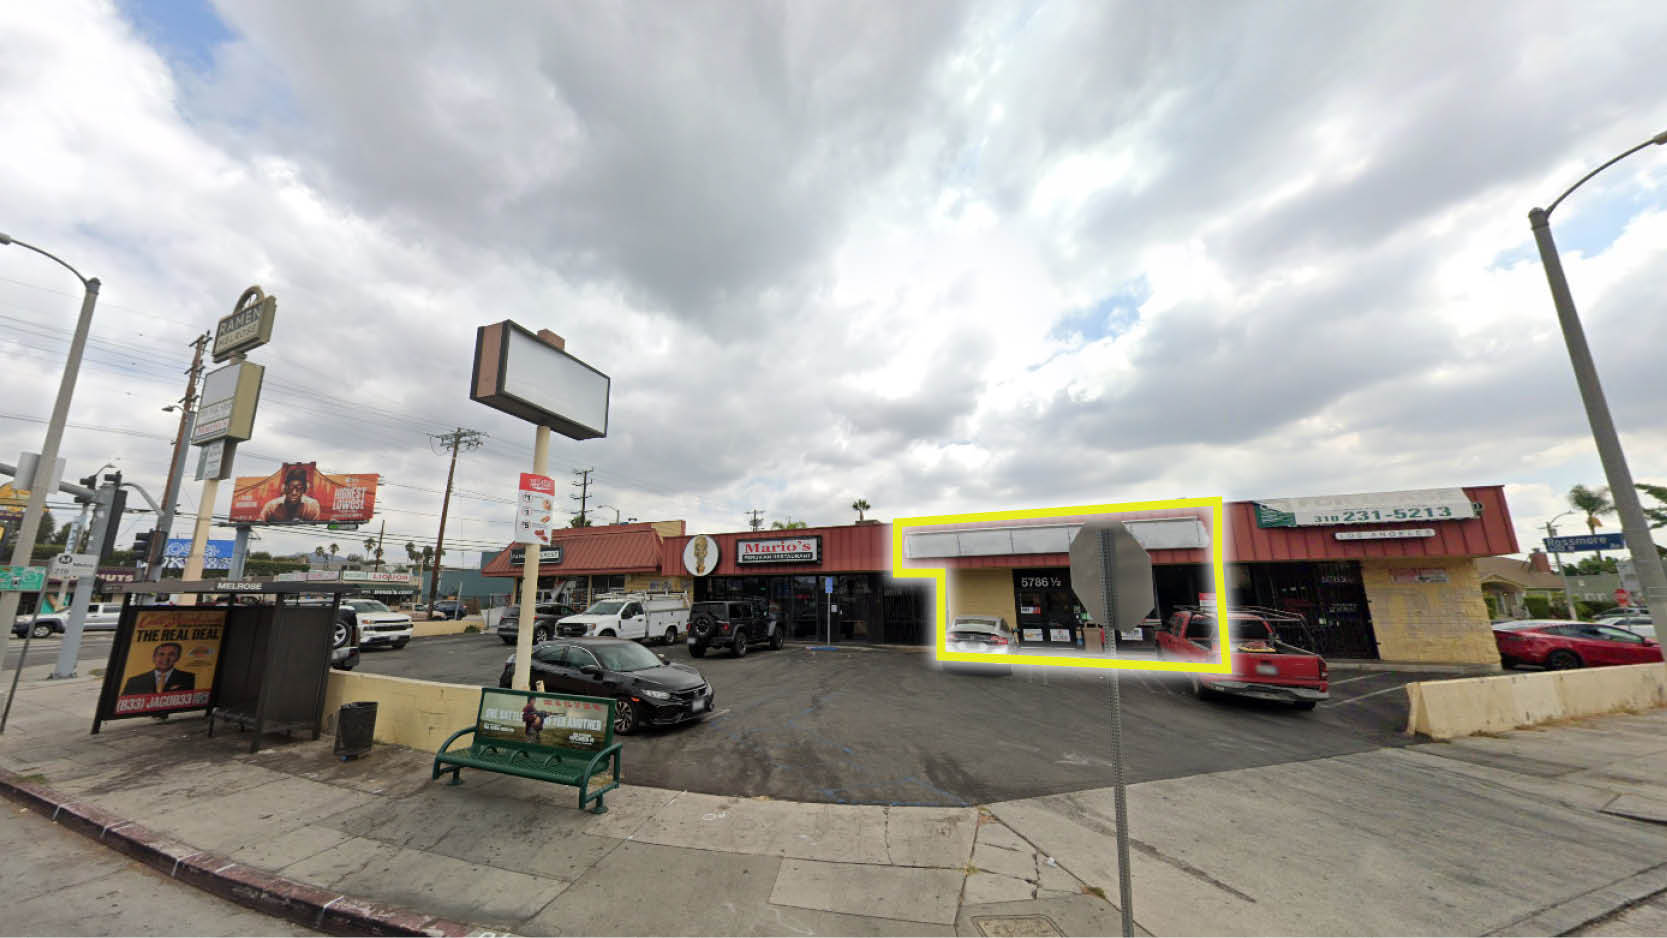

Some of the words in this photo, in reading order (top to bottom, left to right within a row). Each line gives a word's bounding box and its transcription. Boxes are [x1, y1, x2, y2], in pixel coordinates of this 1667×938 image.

[219, 304, 263, 336] RAMEN
[1343, 506, 1452, 522] 231-5213
[745, 540, 812, 553] Mario's
[1547, 536, 1608, 546] Rossmore
[217, 582, 263, 590] MELROSE
[1021, 577, 1049, 588] 5786
[137, 629, 159, 642] THE
[161, 629, 188, 641] REAL
[192, 628, 219, 640] DEAL
